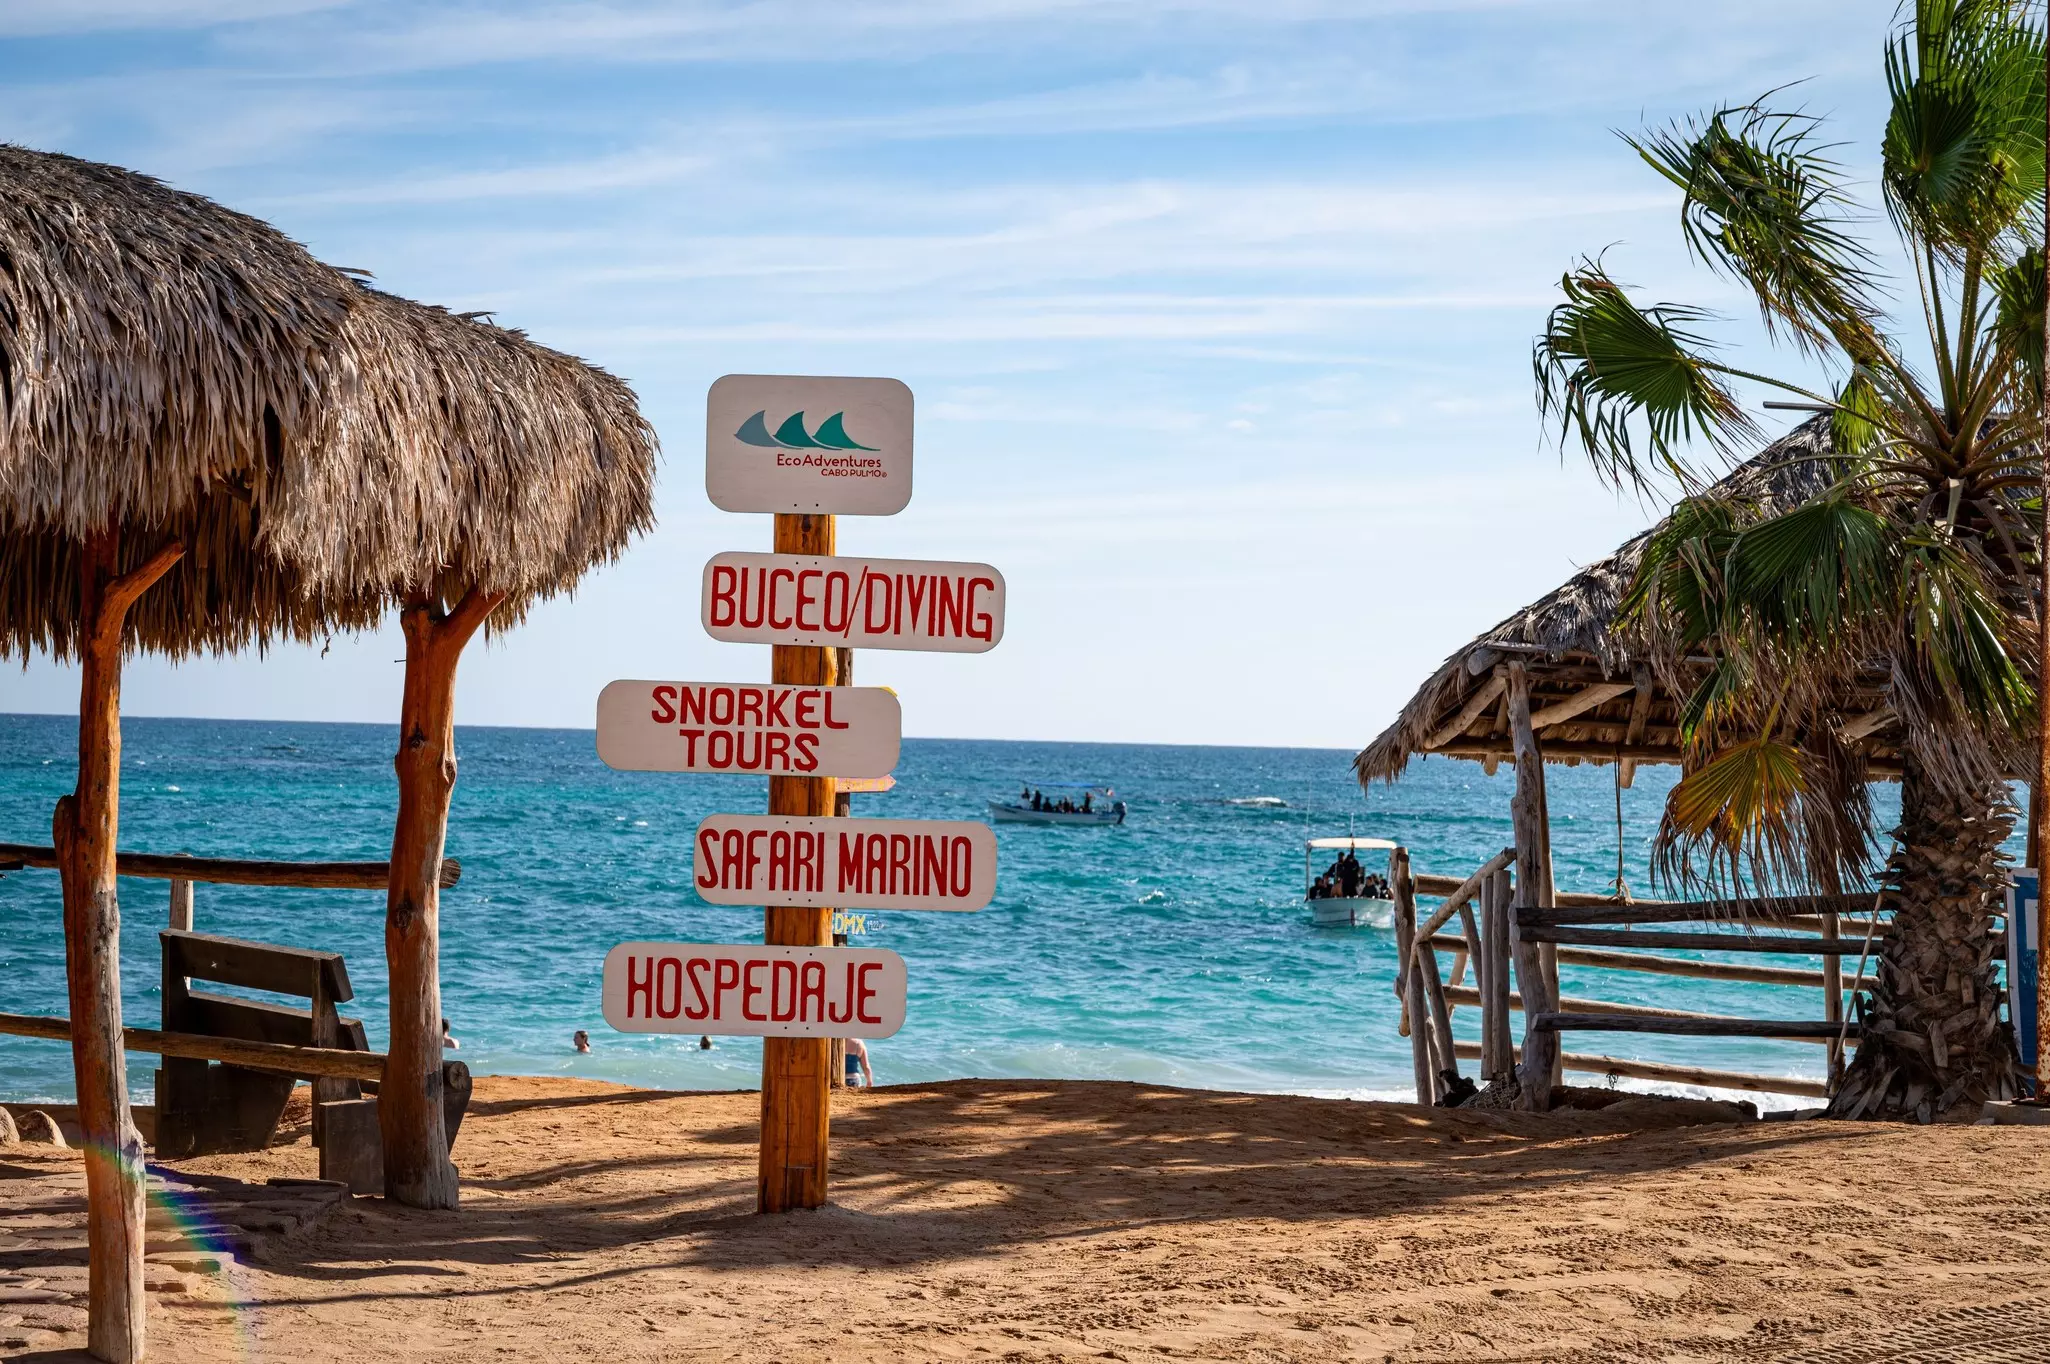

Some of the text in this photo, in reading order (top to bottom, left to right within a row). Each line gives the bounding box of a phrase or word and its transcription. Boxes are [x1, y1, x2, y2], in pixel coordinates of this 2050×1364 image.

[777, 454, 881, 467] EcoAdventures
[821, 468, 849, 477] CABO
[710, 565, 995, 642] BUCEO/DIVING
[651, 685, 849, 730] SNORKEL
[679, 729, 820, 772] TOURS
[697, 828, 972, 898] SAFARI MARINO
[627, 956, 883, 1024] HOSPEDAJE
